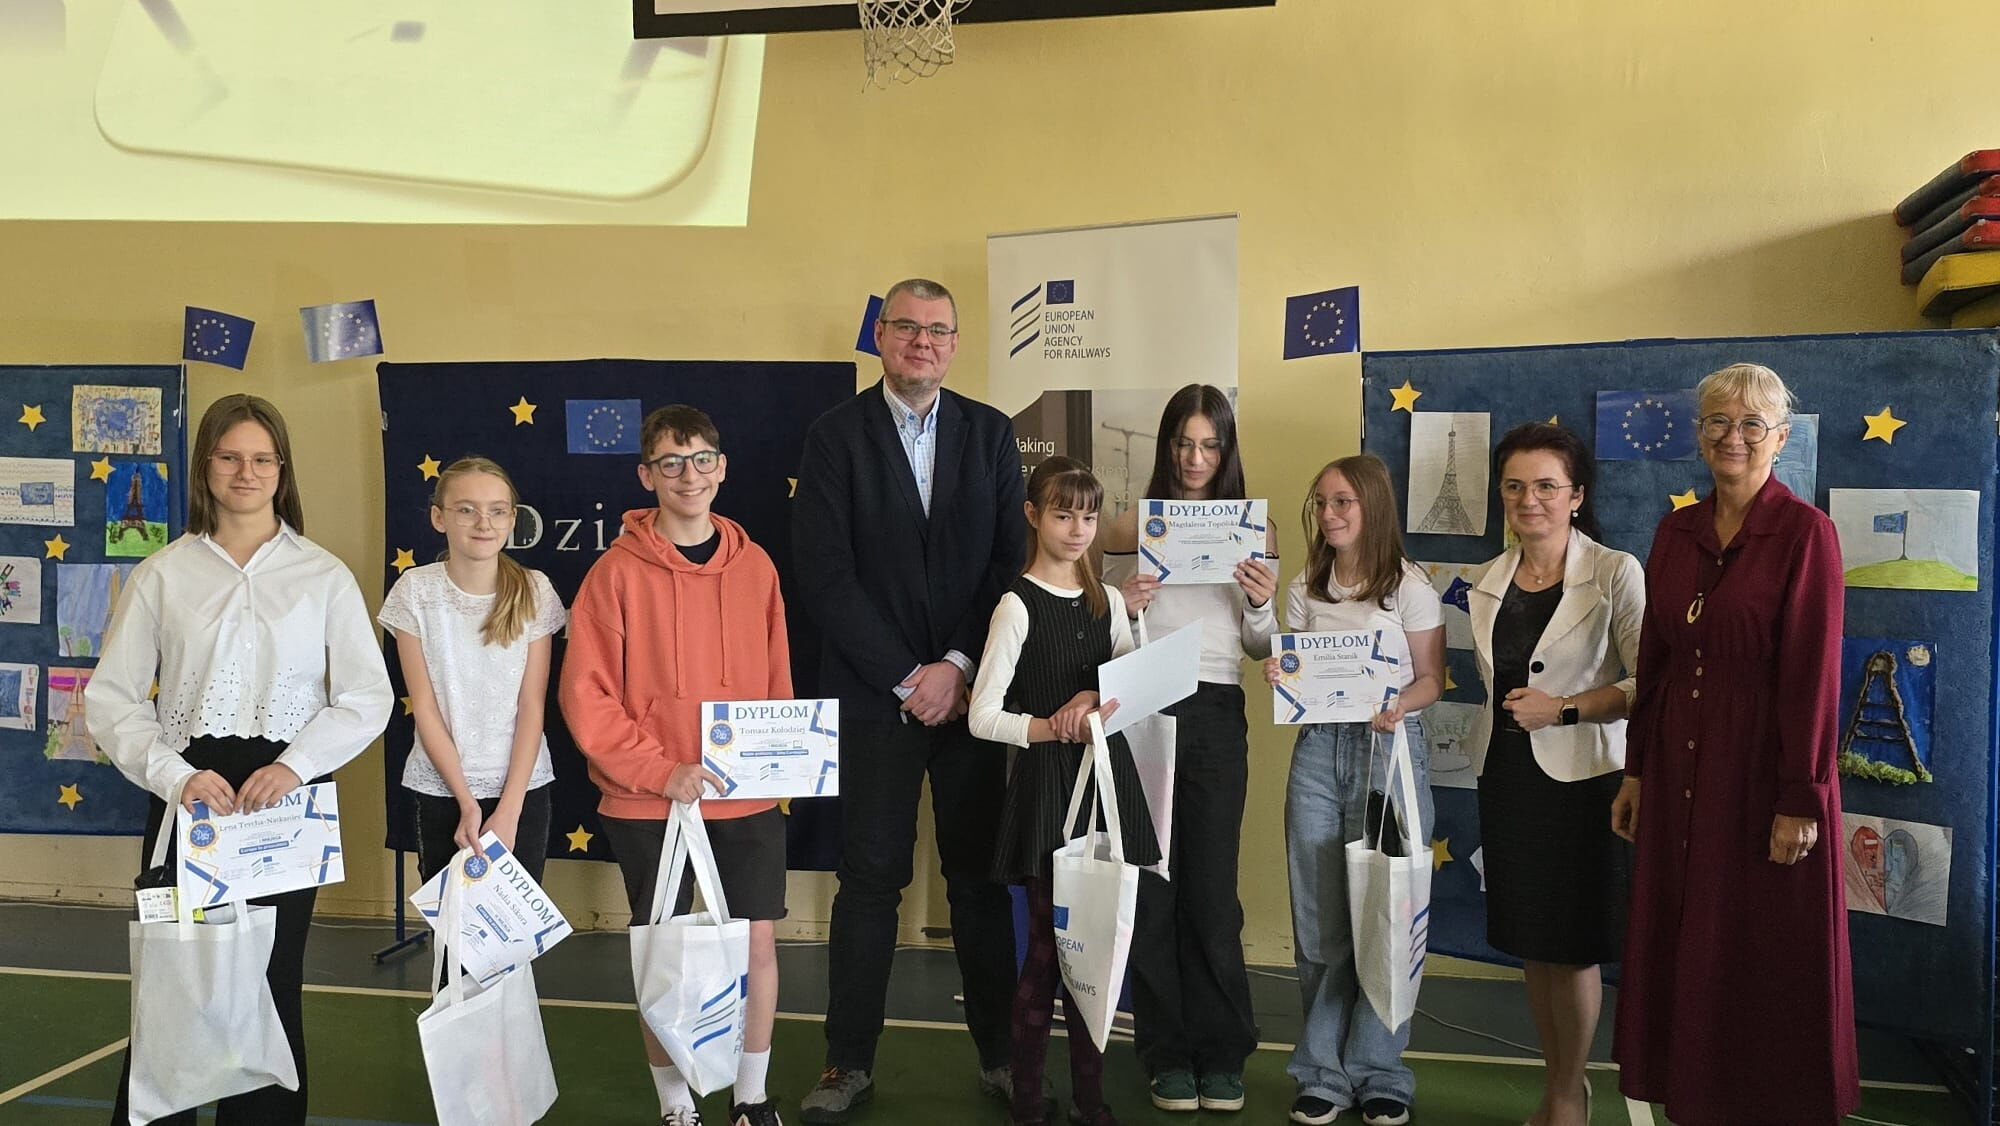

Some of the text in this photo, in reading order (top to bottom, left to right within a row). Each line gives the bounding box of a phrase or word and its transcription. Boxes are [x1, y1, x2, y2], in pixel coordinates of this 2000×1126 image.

[1045, 310, 1095, 322] EUROPEAN
[1044, 323, 1075, 334] UNION
[1044, 336, 1083, 347] AGENCY
[1044, 347, 1111, 359] FOR RAILWAYS
[1169, 504, 1239, 517] DYPLOM
[504, 502, 625, 551] Dzi
[1168, 520, 1206, 529] Magdalena
[1300, 634, 1370, 650] DYPLOM
[735, 705, 809, 720] DYPLOM
[739, 726, 769, 735] Tomasz
[498, 860, 556, 925] DYPLOM
[493, 884, 513, 906] Nadia
[508, 903, 529, 926] Sikora
[1056, 936, 1085, 953] OPEAN
